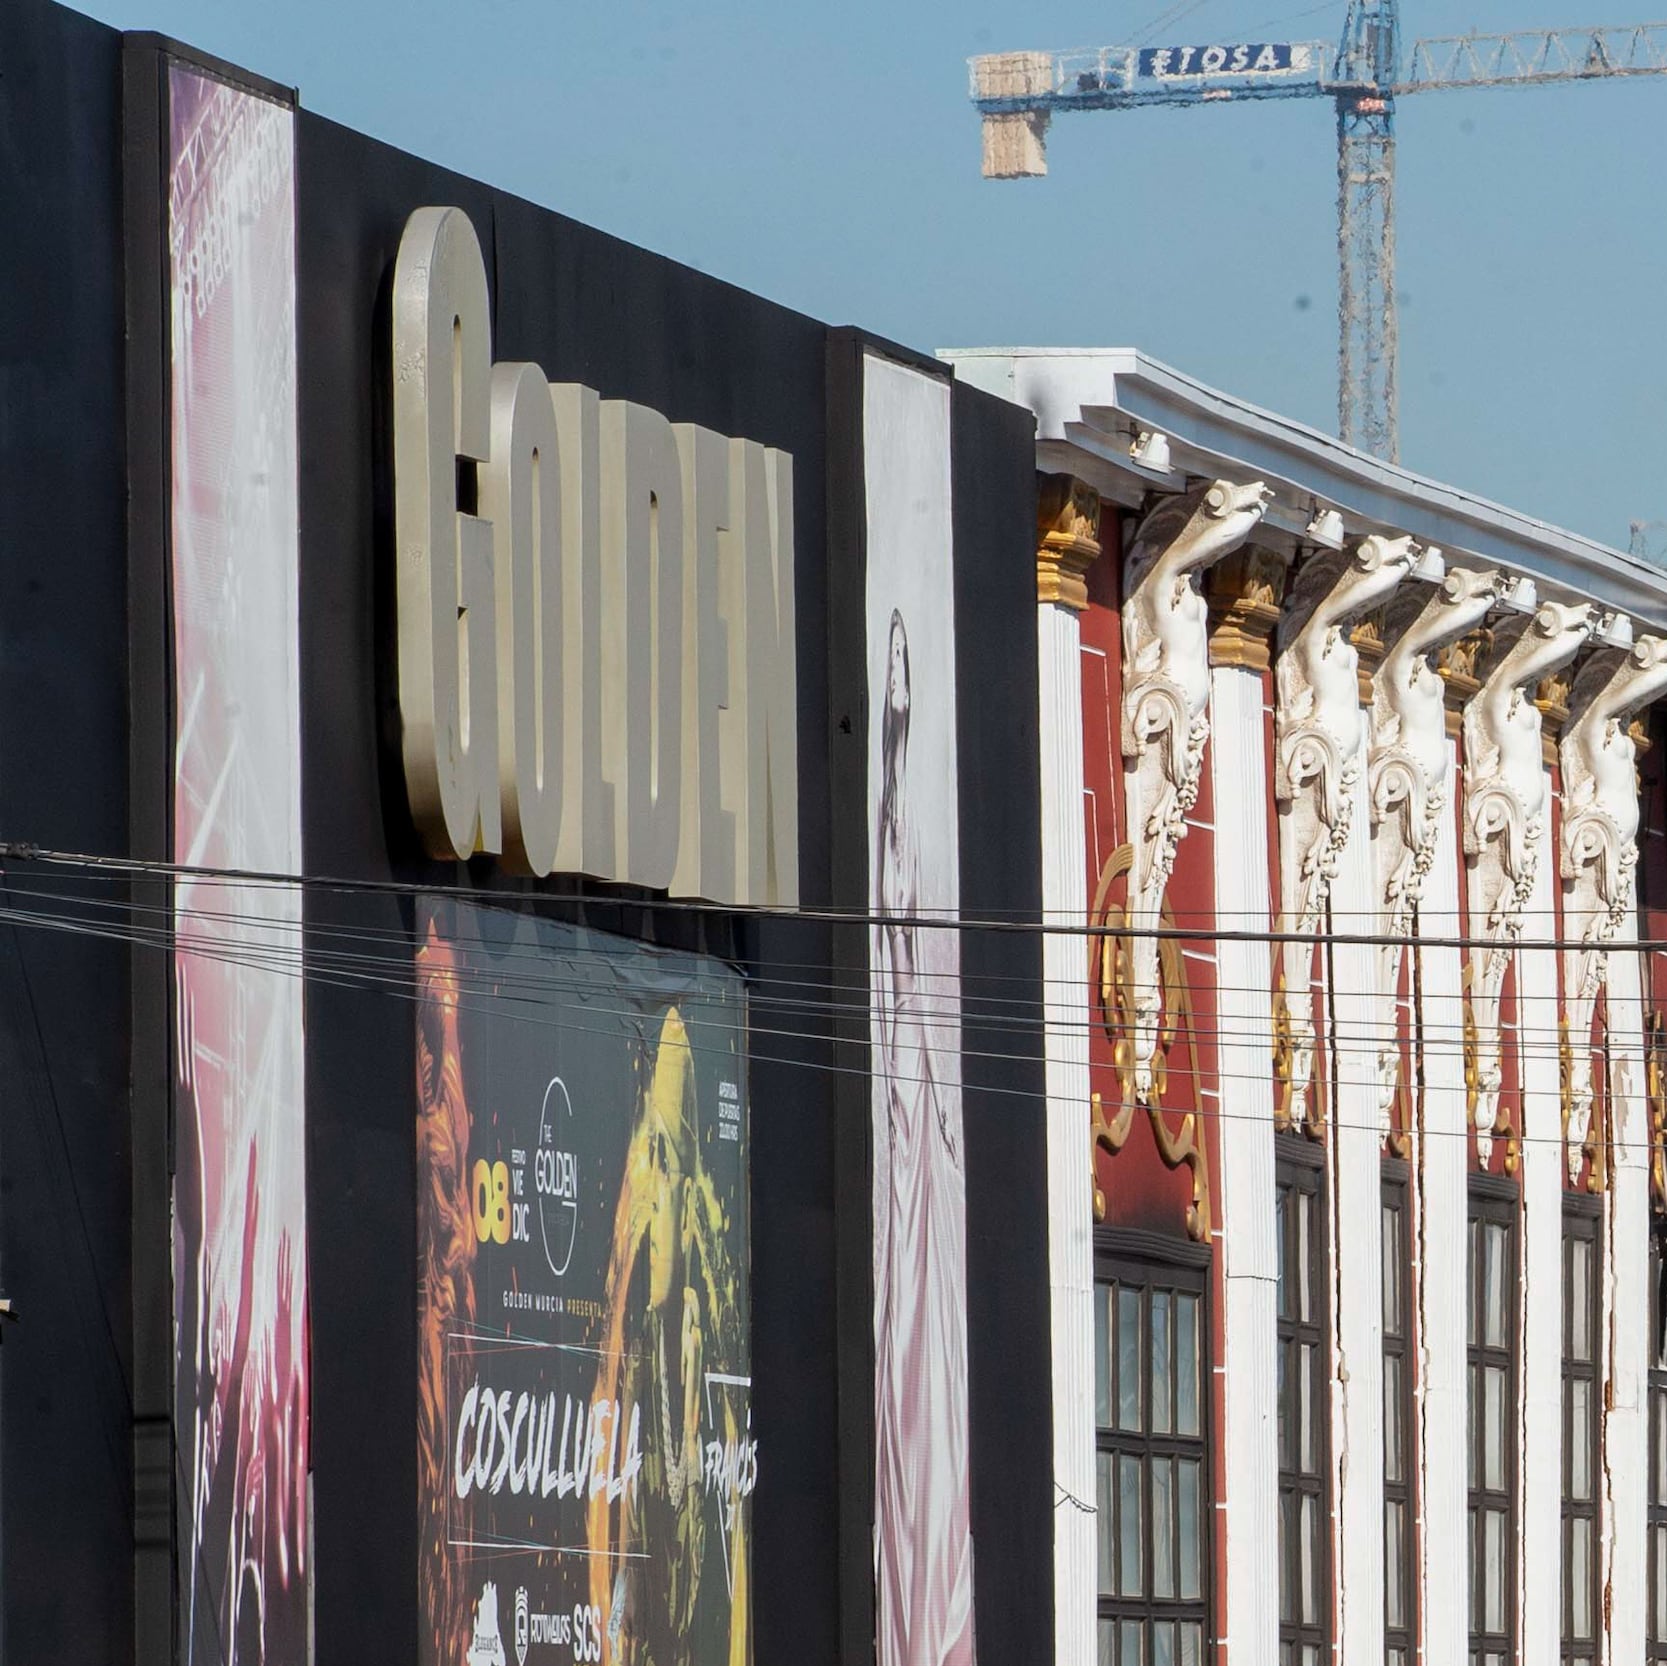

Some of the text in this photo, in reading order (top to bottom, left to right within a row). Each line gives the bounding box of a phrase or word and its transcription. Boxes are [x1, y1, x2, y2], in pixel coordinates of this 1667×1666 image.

[1150, 45, 1279, 78] ETOSA
[392, 205, 799, 910] GOLDEN
[512, 1169, 524, 1196] VIE
[535, 1148, 577, 1199] GOLDEN
[472, 1158, 511, 1245] 08
[512, 1203, 530, 1242] DIC
[503, 1291, 602, 1318] GOLDEN MURCIA PRESENTA
[455, 1379, 643, 1512] COSCULLUELA
[573, 1603, 601, 1662] SCS
